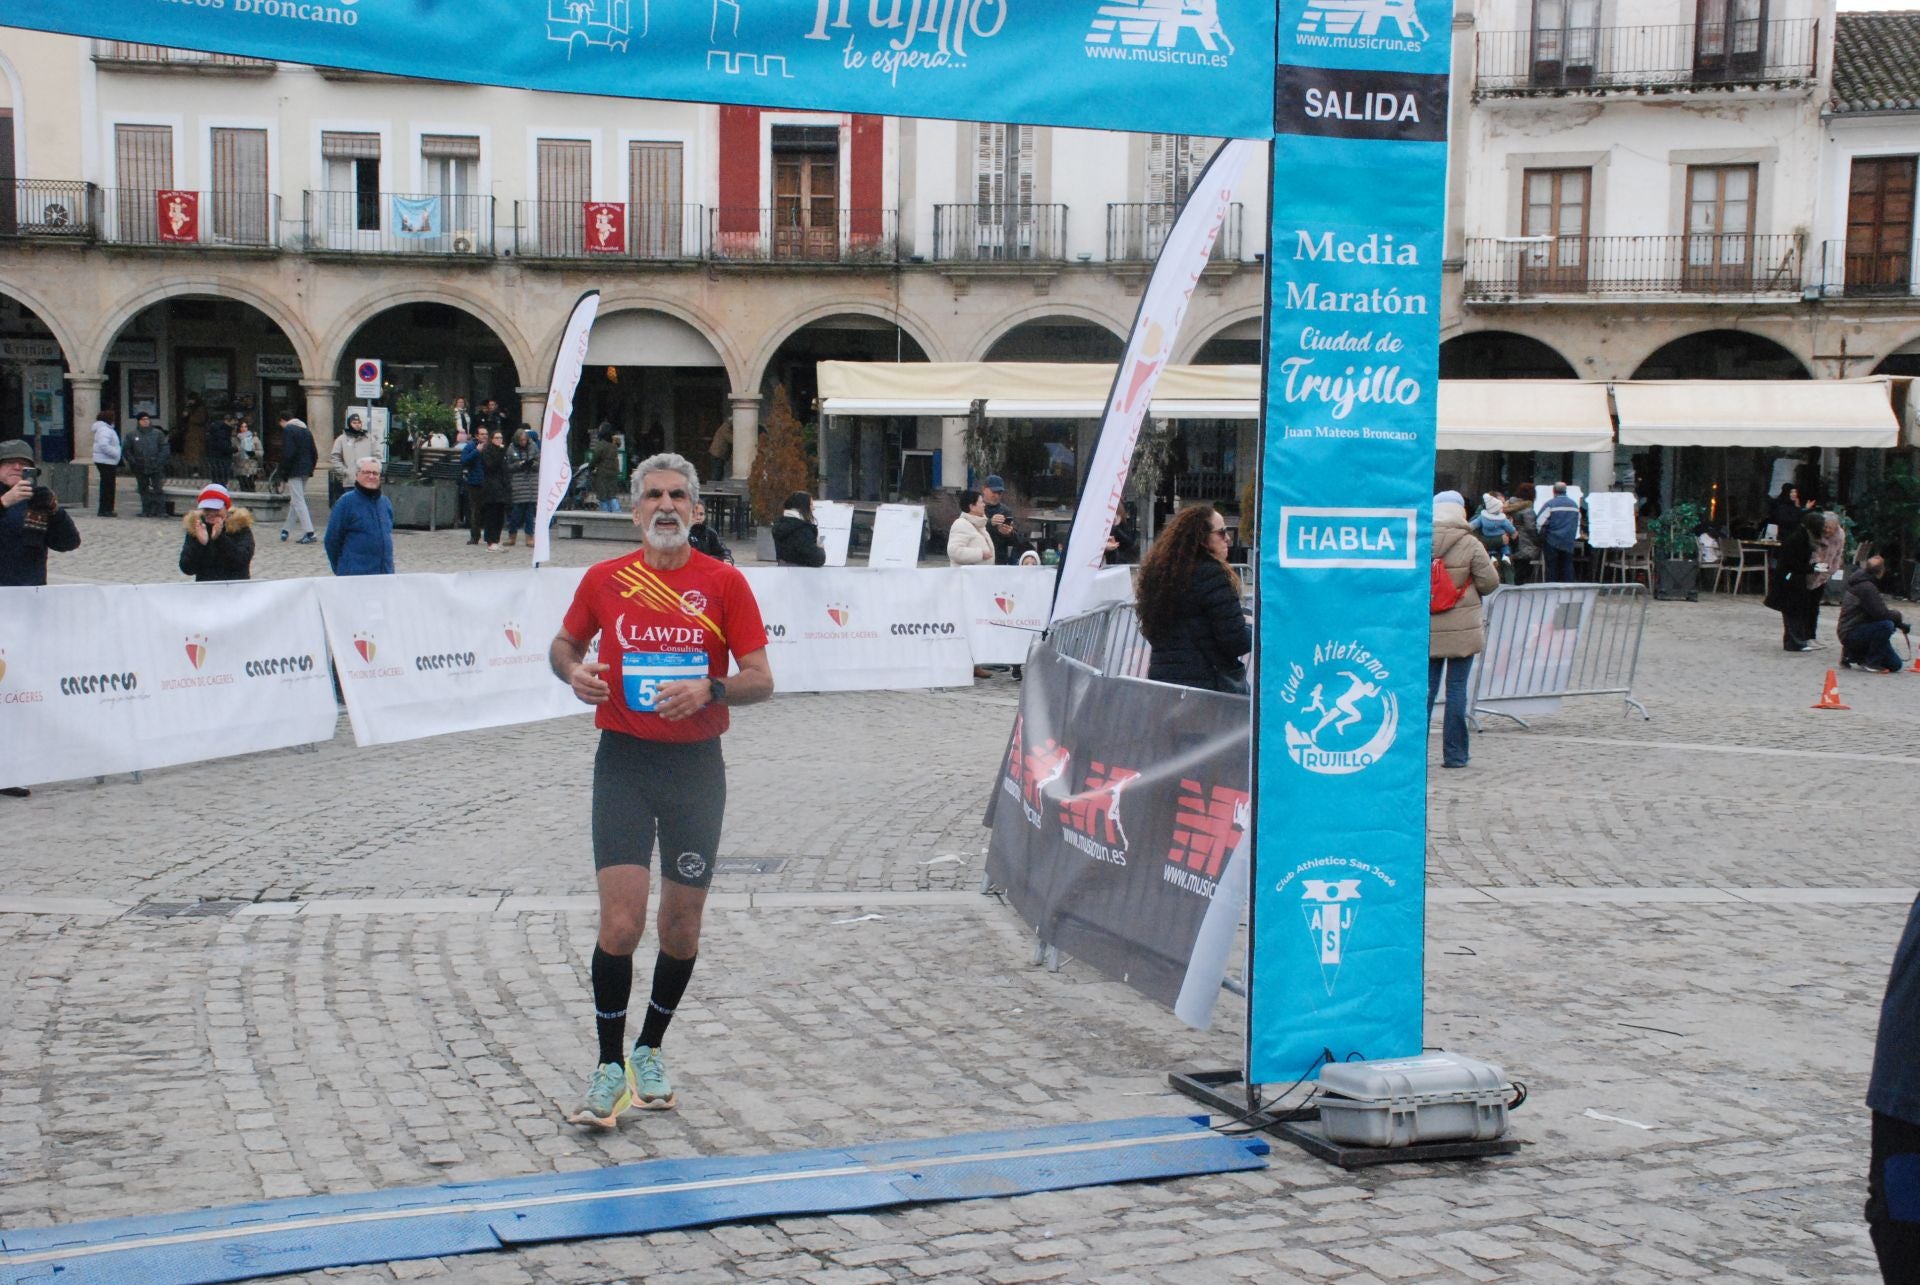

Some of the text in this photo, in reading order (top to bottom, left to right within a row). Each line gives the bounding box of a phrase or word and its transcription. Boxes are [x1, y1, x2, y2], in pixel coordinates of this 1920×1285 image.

[843, 33, 867, 69] te
[1085, 45, 1229, 68] www.musicrun.es
[1296, 34, 1422, 53] www.musicrun.es
[1304, 88, 1420, 122] SALIDA
[1293, 230, 1419, 265] Media
[1285, 281, 1428, 315] Maratón
[1301, 326, 1404, 353] Ciudad de
[1281, 357, 1421, 420] Trujillo
[1284, 426, 1417, 441] Juan Mateos Broncano
[1298, 527, 1395, 551] HABLA
[630, 625, 704, 644] LAWDE
[1281, 640, 1390, 704] Club Atletismo
[1062, 826, 1127, 866] www.musicun.es
[1163, 863, 1217, 900] www.music
[1276, 871, 1295, 892] Club
[1296, 856, 1347, 874] Athletico
[1349, 858, 1371, 872] San
